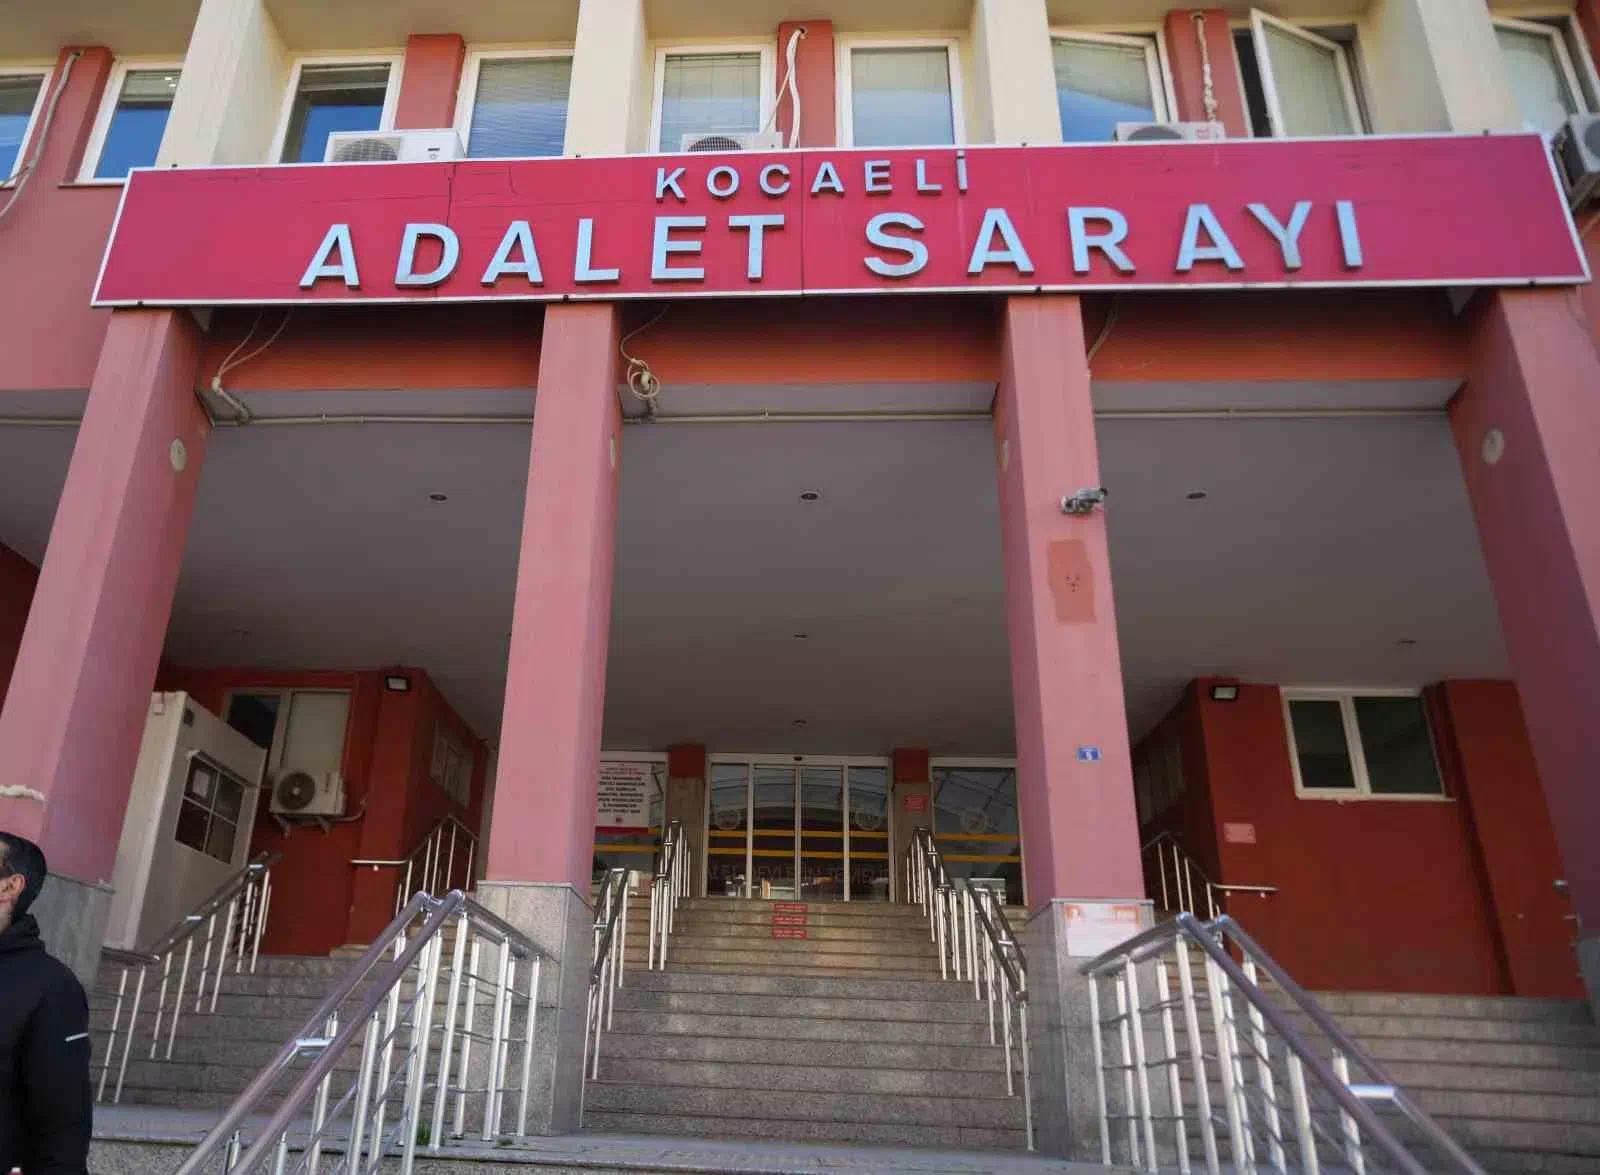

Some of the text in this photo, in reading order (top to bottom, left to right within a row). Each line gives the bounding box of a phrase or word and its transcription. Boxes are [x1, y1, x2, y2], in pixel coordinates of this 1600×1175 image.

[655, 150, 968, 201] KOCAELİ
[299, 200, 1363, 289] ADALET SARAYI
